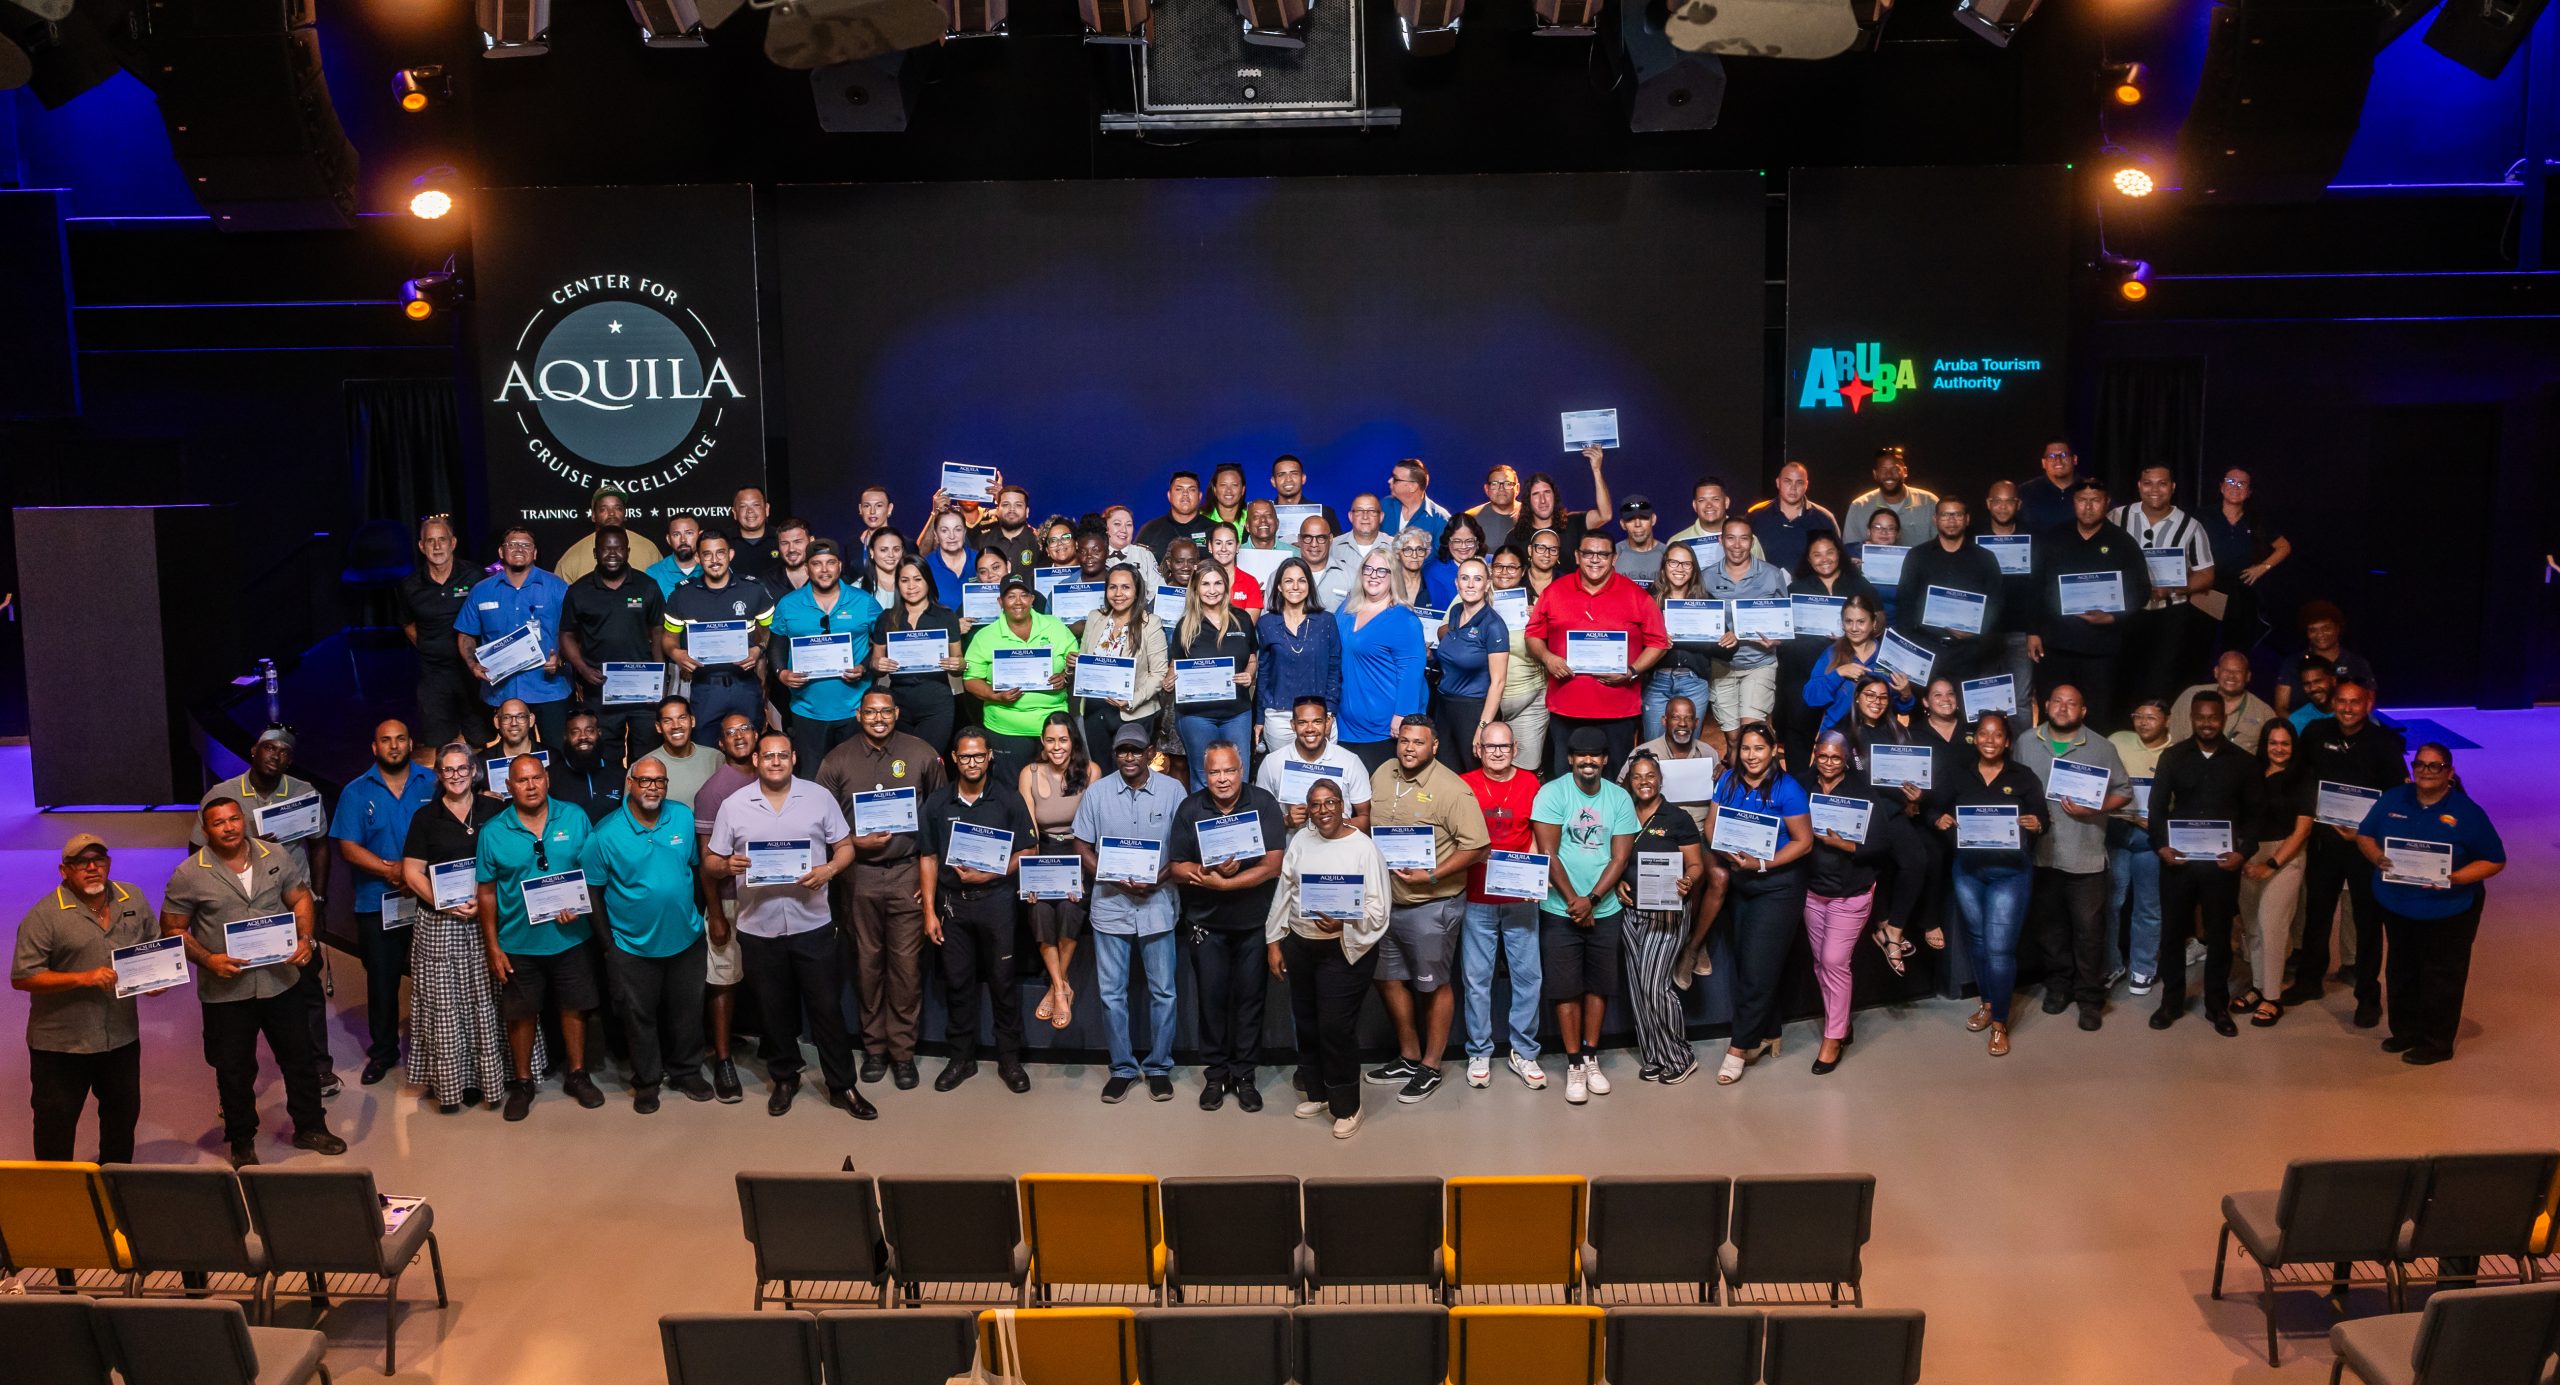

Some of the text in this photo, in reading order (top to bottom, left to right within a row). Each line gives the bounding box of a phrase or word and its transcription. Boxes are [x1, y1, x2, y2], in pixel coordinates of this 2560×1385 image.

[552, 274, 678, 305] CENTER FOR
[1933, 358, 2041, 371] Aruba Tourism
[1799, 342, 1917, 408] ARUBA
[493, 357, 746, 411] AQUILA
[1933, 376, 2002, 391] Authority
[529, 434, 717, 494] CRUISE EXCELLENCE
[520, 508, 578, 521] TRAINING
[1216, 817, 1239, 825] AQUILA
[1737, 812, 1759, 820] AQUILA
[971, 827, 993, 835] AQUILA
[247, 919, 272, 927] AQUILA
[135, 942, 160, 951] AQUILA
